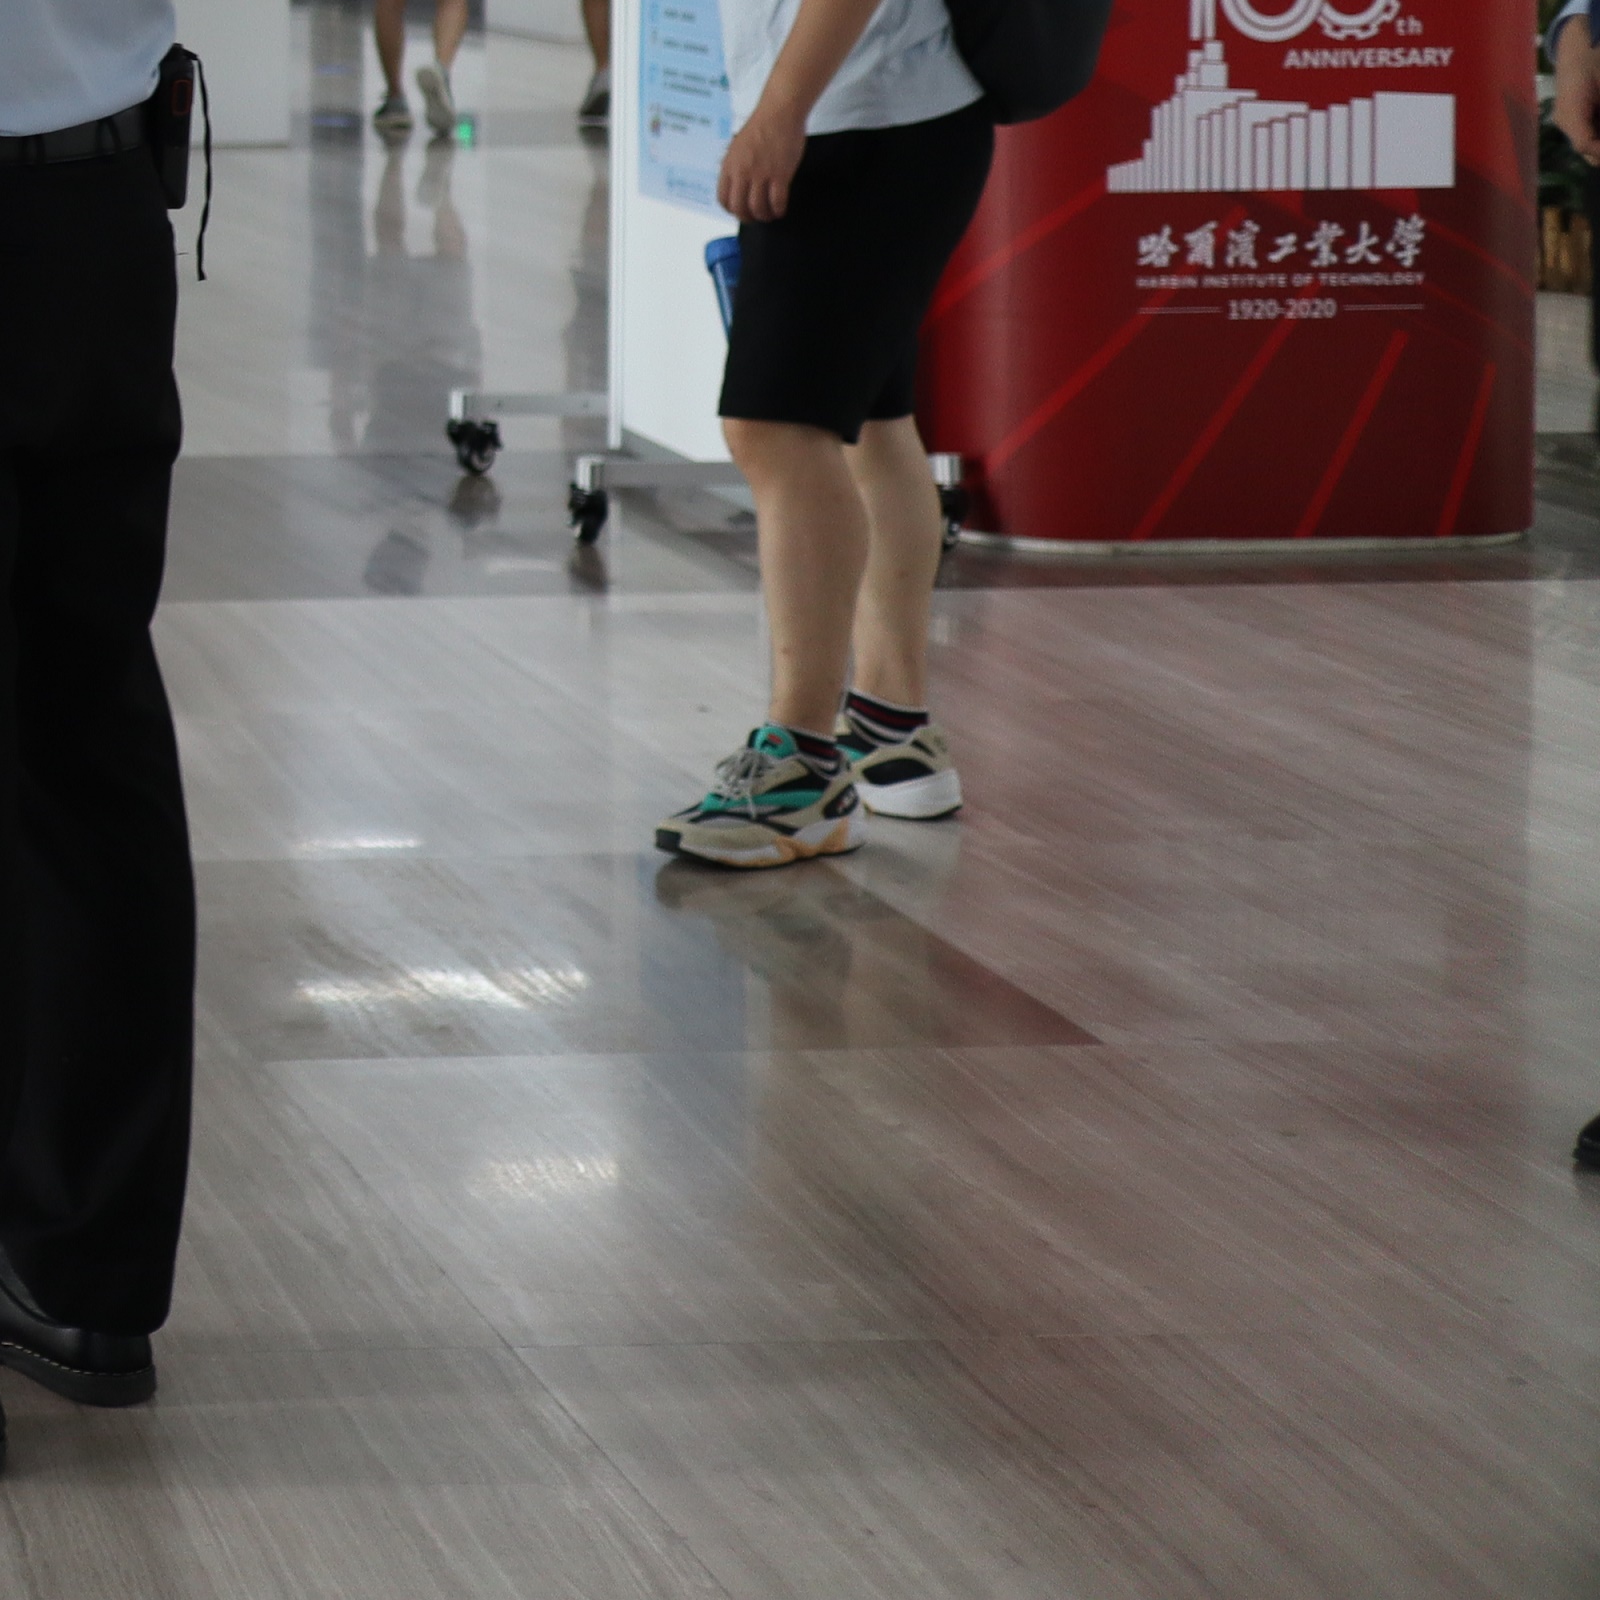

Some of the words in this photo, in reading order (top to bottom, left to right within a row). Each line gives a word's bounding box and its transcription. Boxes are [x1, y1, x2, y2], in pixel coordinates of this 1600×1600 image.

[1283, 47, 1453, 69] ANNIVERSARY
[1136, 275, 1198, 289] HARBIN
[1202, 274, 1288, 288] INSTITUTE
[1291, 273, 1315, 288] OF
[1318, 271, 1425, 287] TECHNOLOGY
[1227, 298, 1337, 320] 1920-2020
